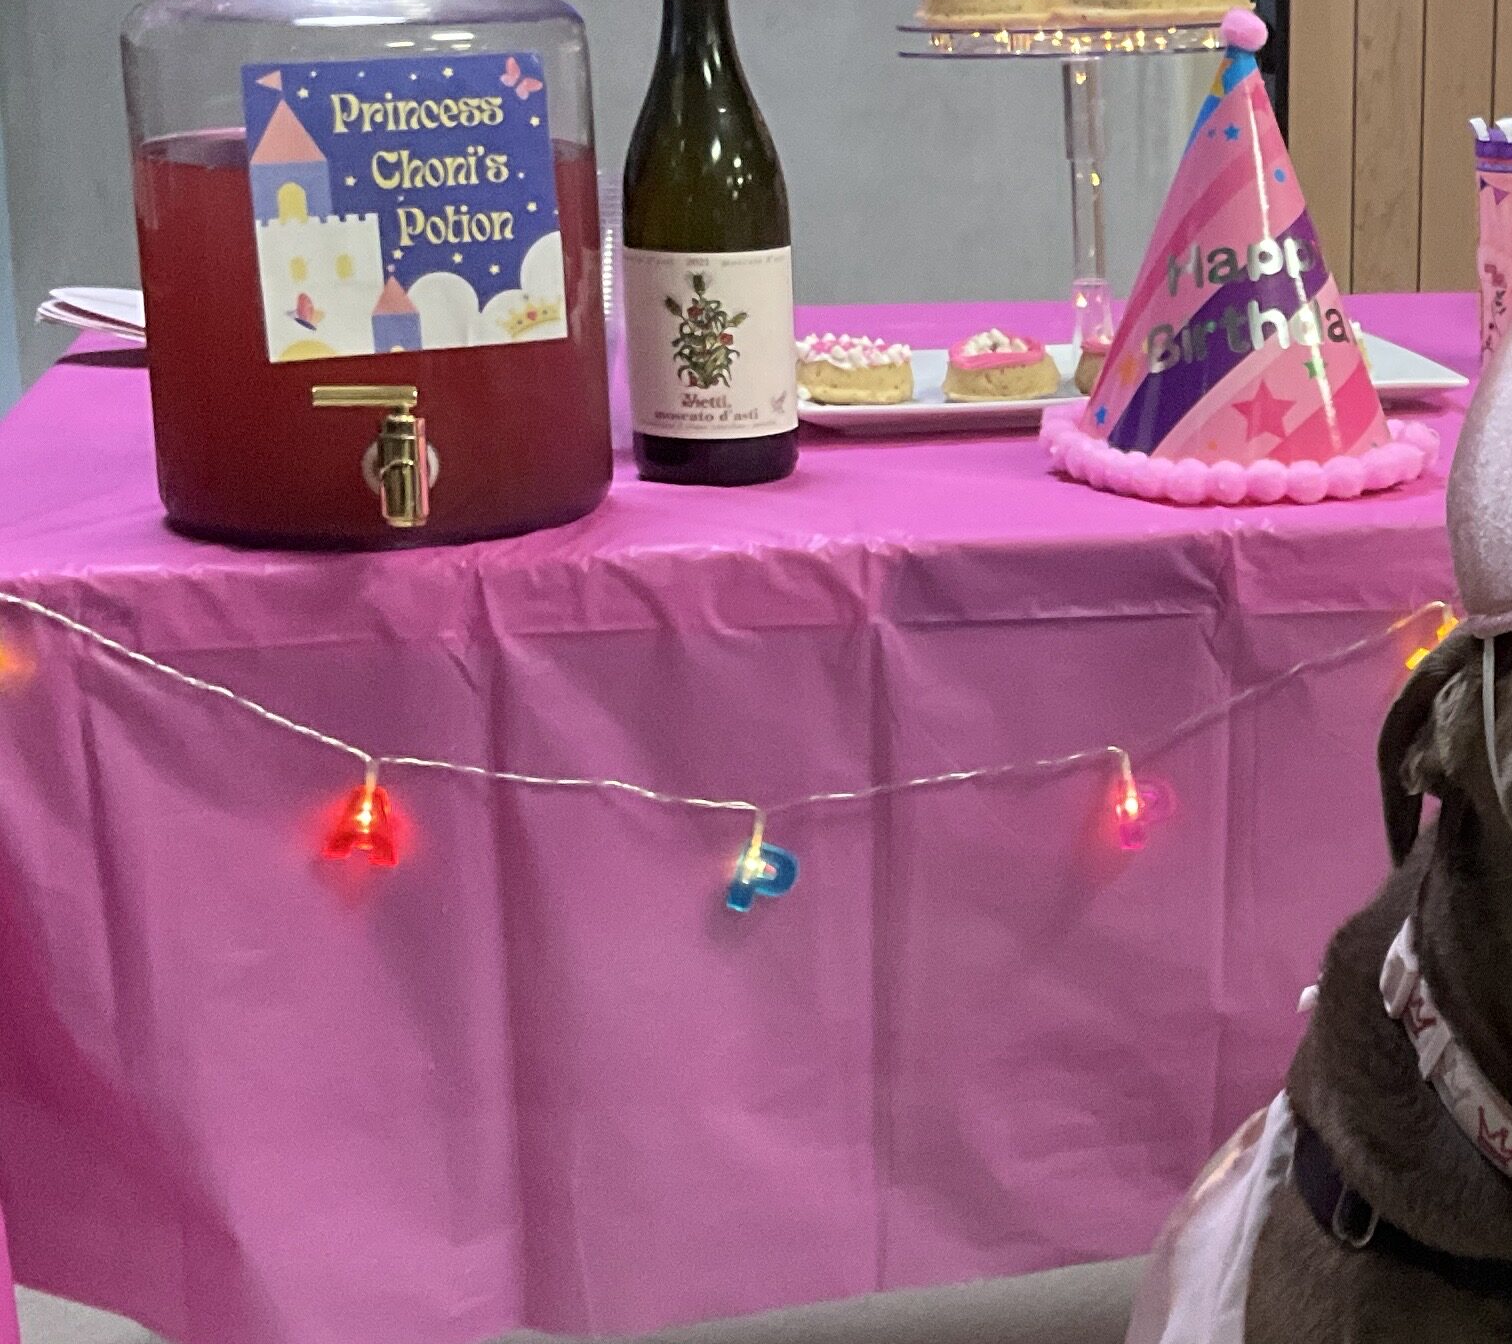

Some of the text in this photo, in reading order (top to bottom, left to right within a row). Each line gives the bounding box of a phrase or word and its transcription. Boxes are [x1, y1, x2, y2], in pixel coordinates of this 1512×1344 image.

[331, 92, 504, 133] Princess
[371, 146, 509, 189] Choni's
[397, 205, 514, 246] Potion
[1167, 236, 1318, 298] Happ
[1146, 297, 1350, 374] Birthda
